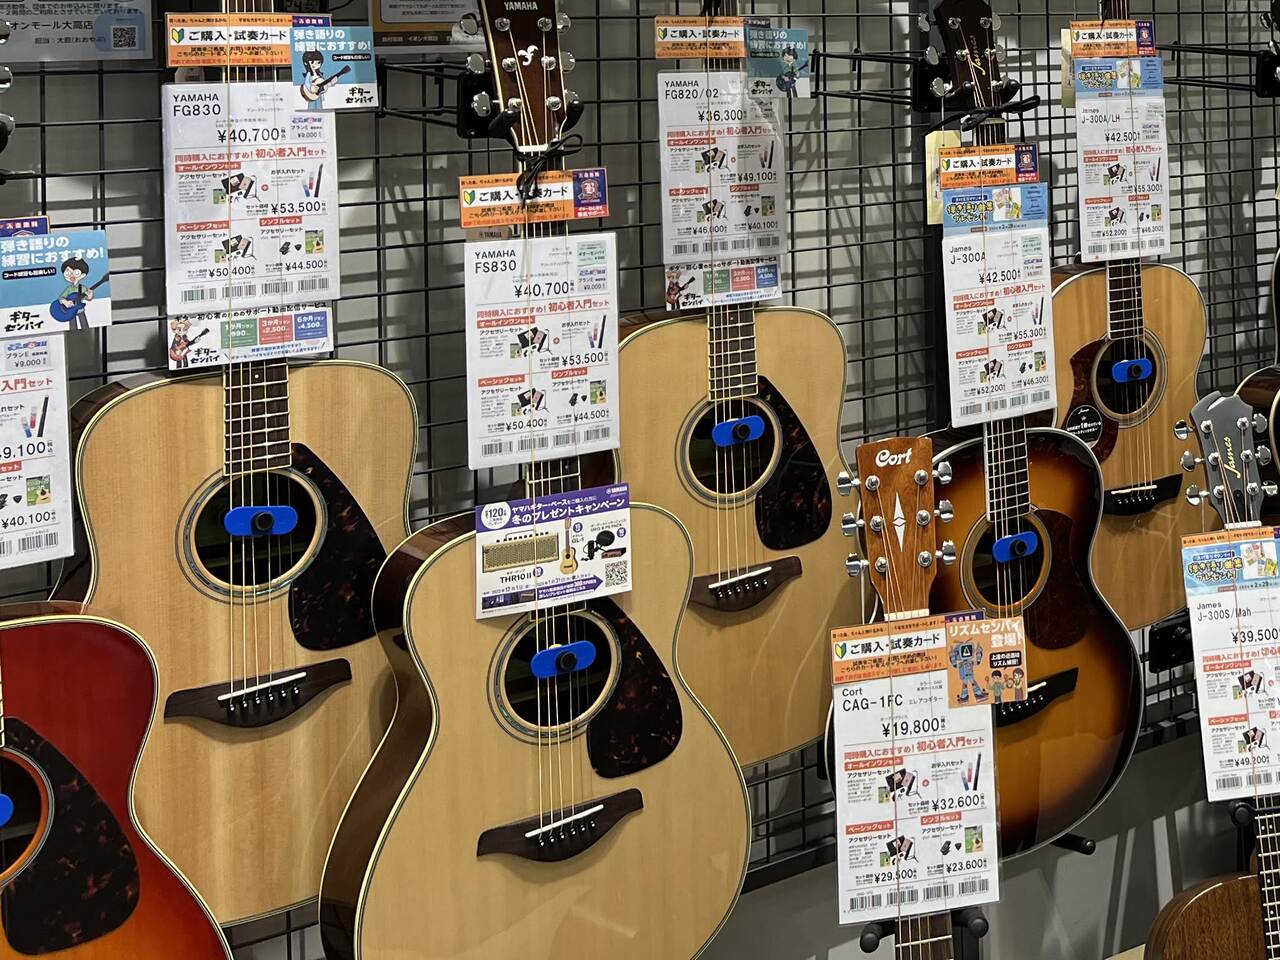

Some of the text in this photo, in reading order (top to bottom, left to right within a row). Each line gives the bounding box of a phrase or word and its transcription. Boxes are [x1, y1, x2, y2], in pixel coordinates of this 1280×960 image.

[504, 2, 538, 11] YAMAHA
[189, 29, 286, 41] ご購入・試奏カード
[294, 29, 345, 40] 弾き語りの
[294, 40, 372, 52] 練習におすすめ!
[173, 93, 219, 102] YAMAHA
[665, 89, 718, 99] FG820/02
[346, 96, 374, 105] センパイ
[174, 104, 221, 116] FG830
[256, 146, 327, 158] 初心者入門セット
[1, 237, 69, 252] 弾き語りの
[1, 248, 103, 266] 練習におすすめ!
[475, 250, 515, 259] YAMAHA
[951, 251, 986, 265] J-300A
[475, 260, 516, 273] FS830
[549, 300, 609, 311] 初心者入門セット
[10, 311, 40, 322] ギター
[5, 321, 44, 331] センパイ
[191, 355, 220, 364] センパイ
[876, 448, 912, 467] Cort
[512, 499, 624, 523] 冬のプレゼントキャンペーン
[500, 573, 526, 583] THR10
[1197, 601, 1221, 610] James
[1198, 607, 1251, 622] J-300S/Mah
[950, 621, 1021, 636] リズムセンパイ
[851, 634, 939, 654] ご購入・試奏カード
[992, 633, 1022, 647] 登場!
[843, 688, 862, 697] Cort
[843, 694, 903, 711] CAG-1FC
[917, 737, 984, 752] 初心者入門セット
